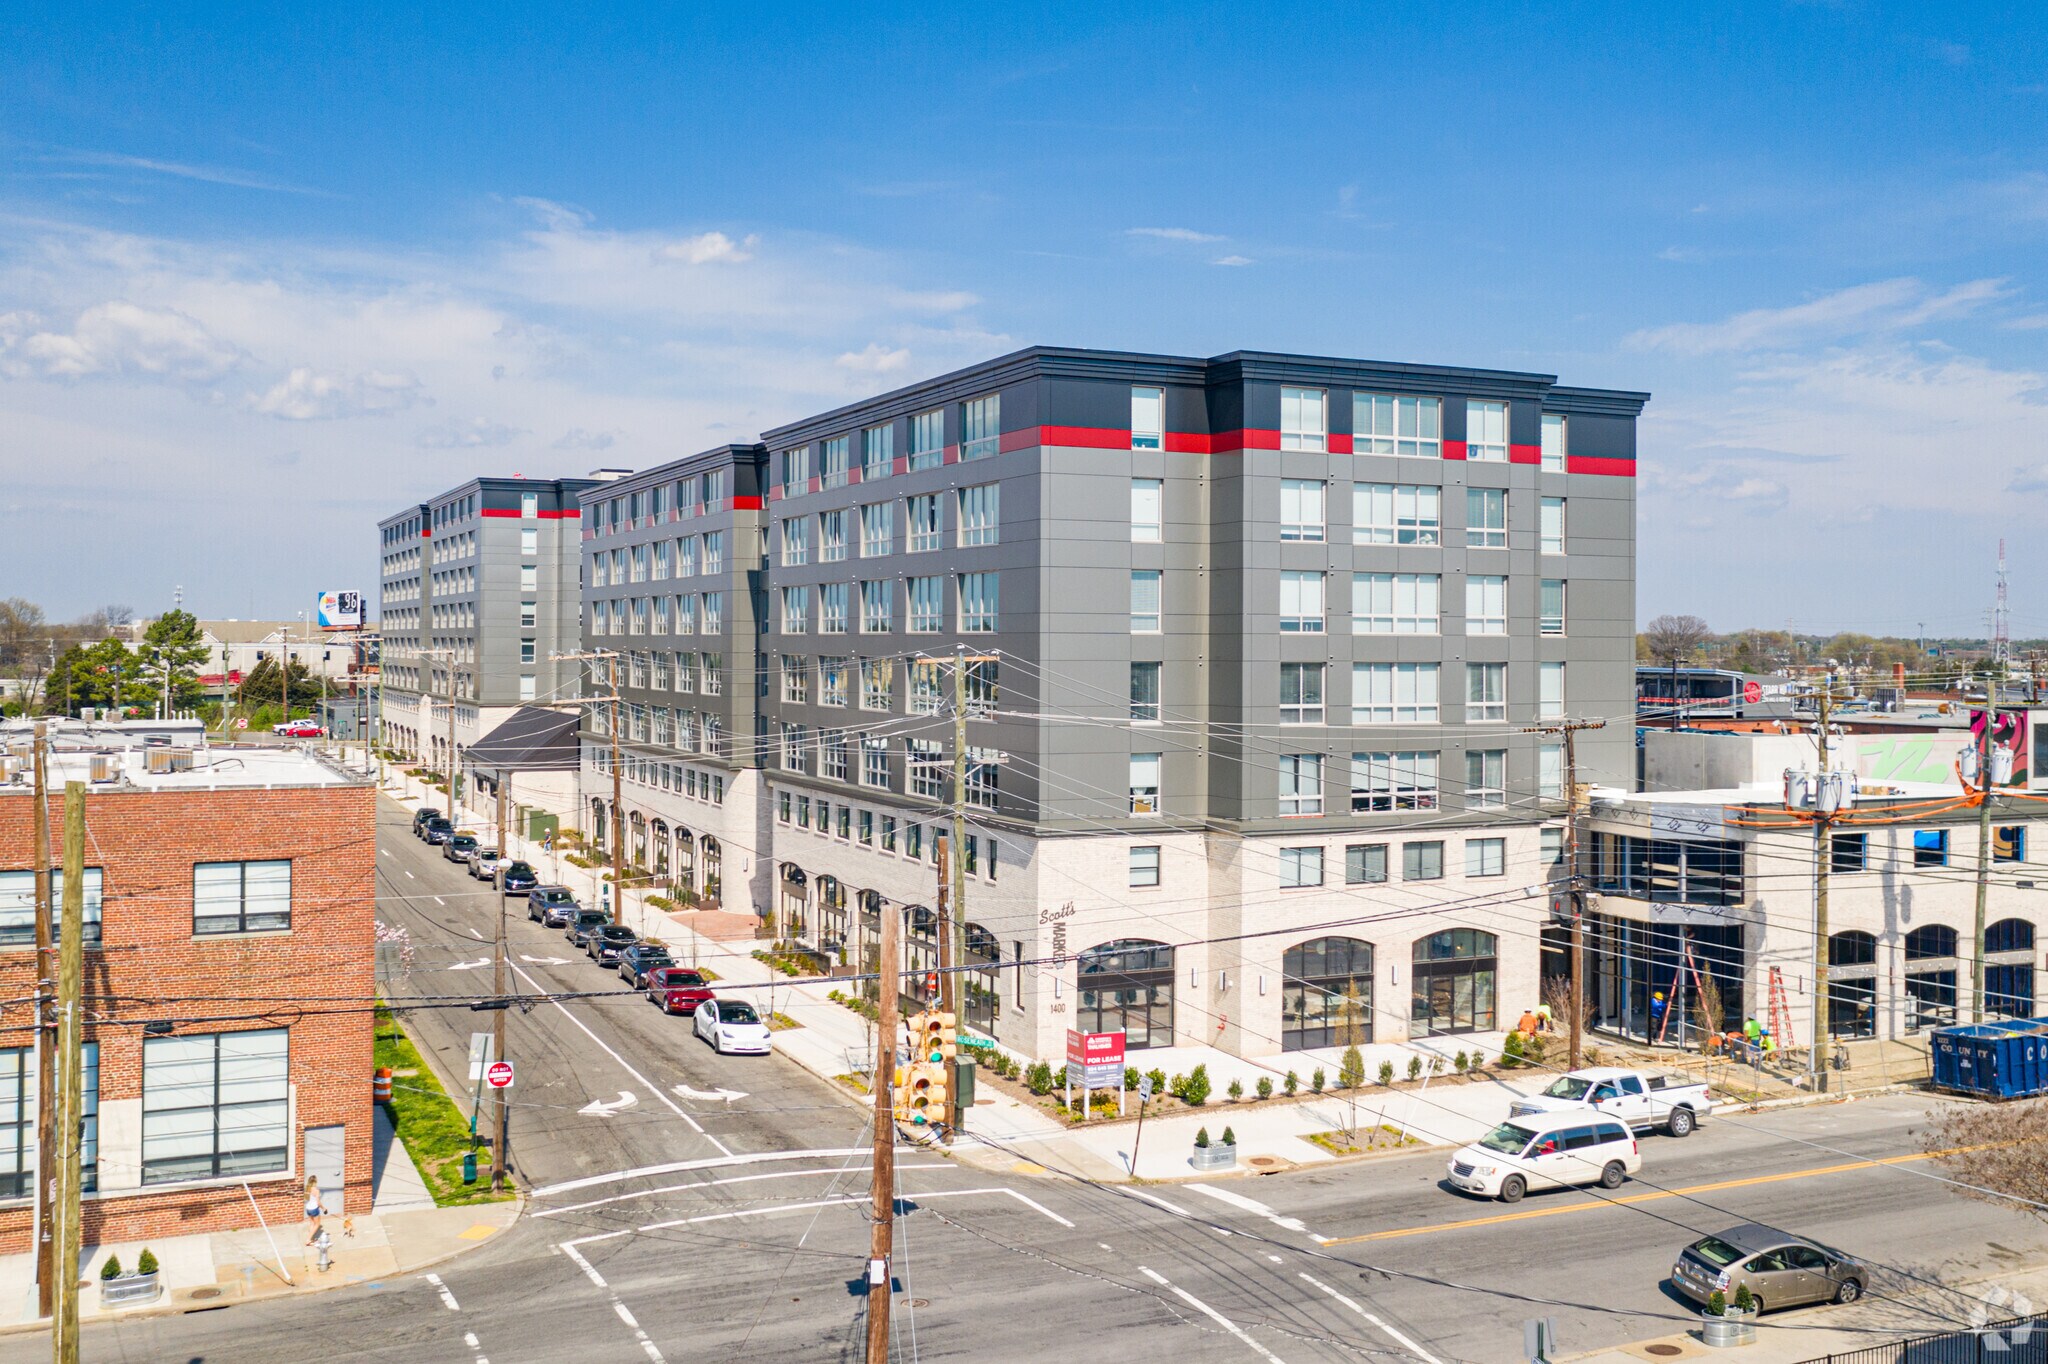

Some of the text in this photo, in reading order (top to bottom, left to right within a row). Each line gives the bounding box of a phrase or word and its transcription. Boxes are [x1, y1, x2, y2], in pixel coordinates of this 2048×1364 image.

[345, 593, 356, 608] 96
[1040, 901, 1076, 925] Scott's
[1053, 922, 1066, 968] MARKE
[1050, 1003, 1066, 1014] 1400
